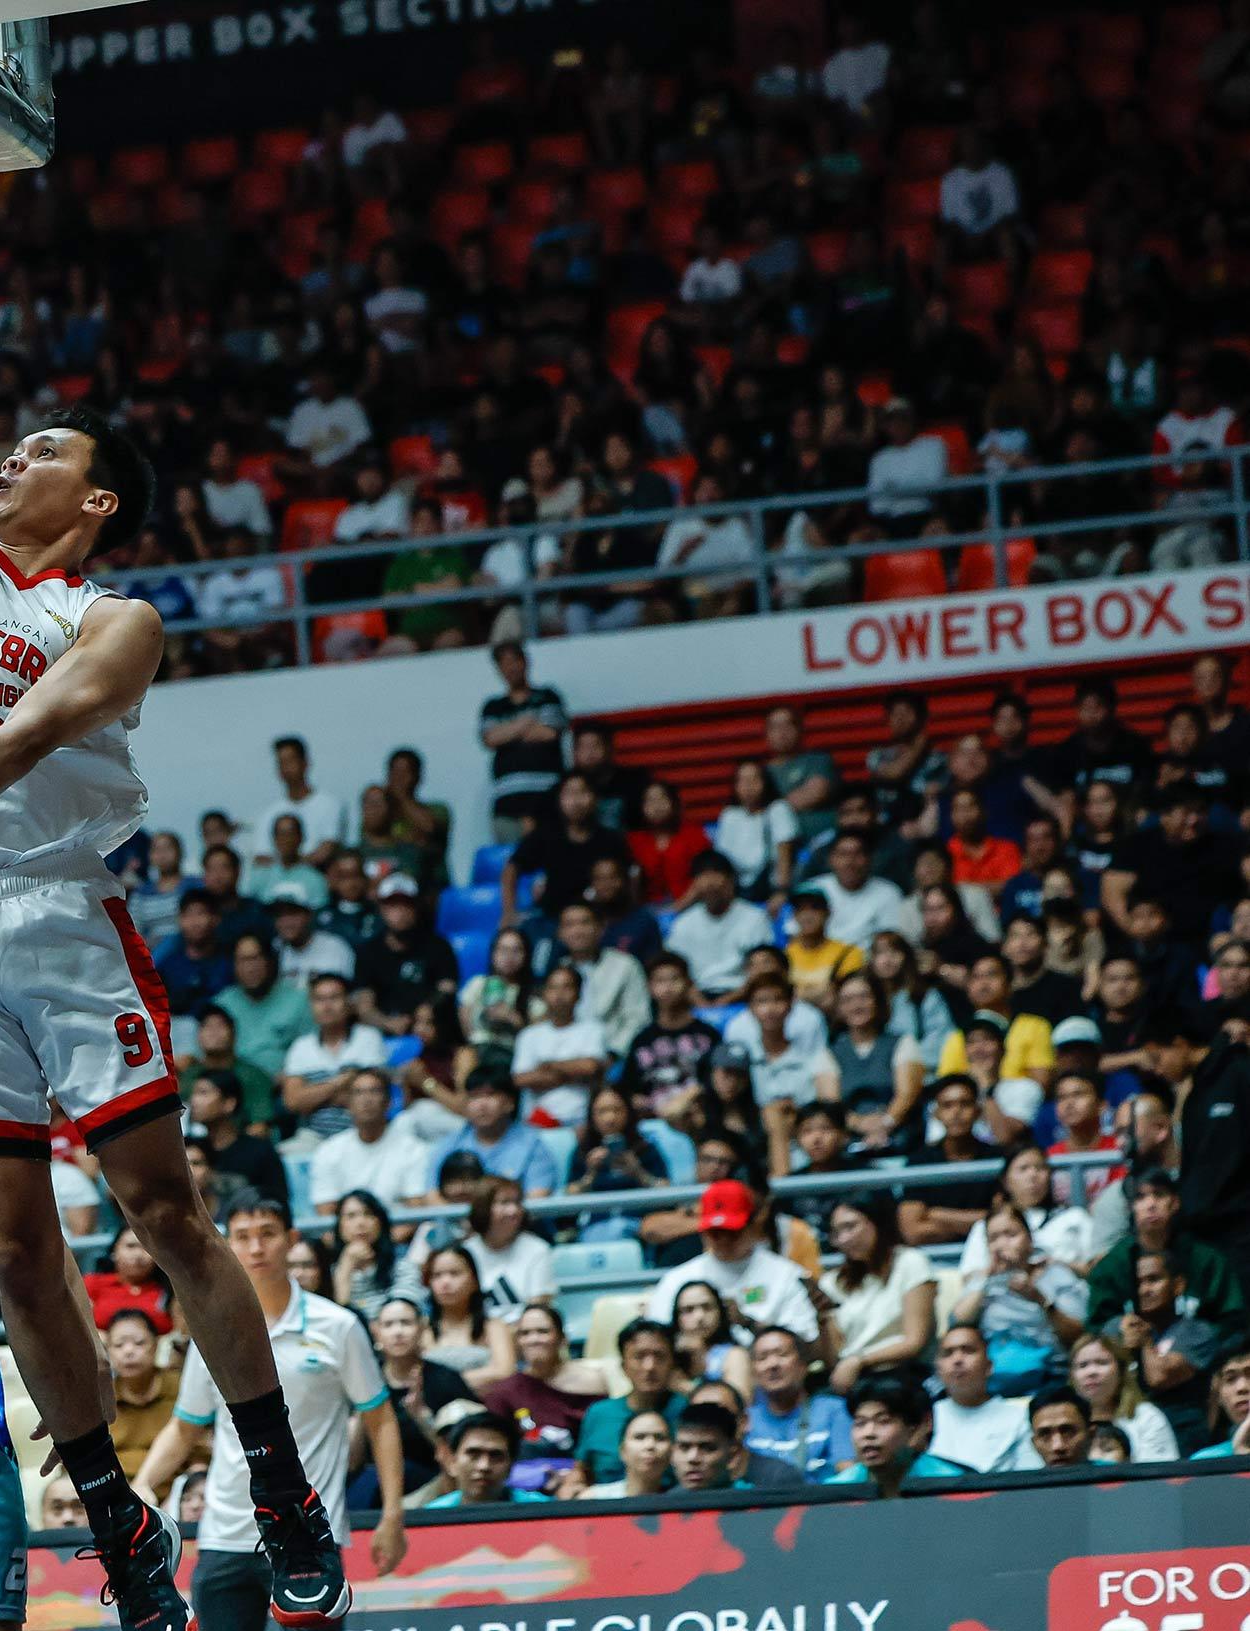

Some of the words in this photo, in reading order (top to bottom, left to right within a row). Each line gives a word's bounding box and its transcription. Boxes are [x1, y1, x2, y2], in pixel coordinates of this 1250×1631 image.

[213, 6, 317, 54] BOX
[802, 600, 1026, 672] LOWER
[1045, 584, 1185, 646] BOX
[1202, 576, 1250, 630] S
[114, 1012, 154, 1068] 9
[1099, 1566, 1198, 1607] FOR
